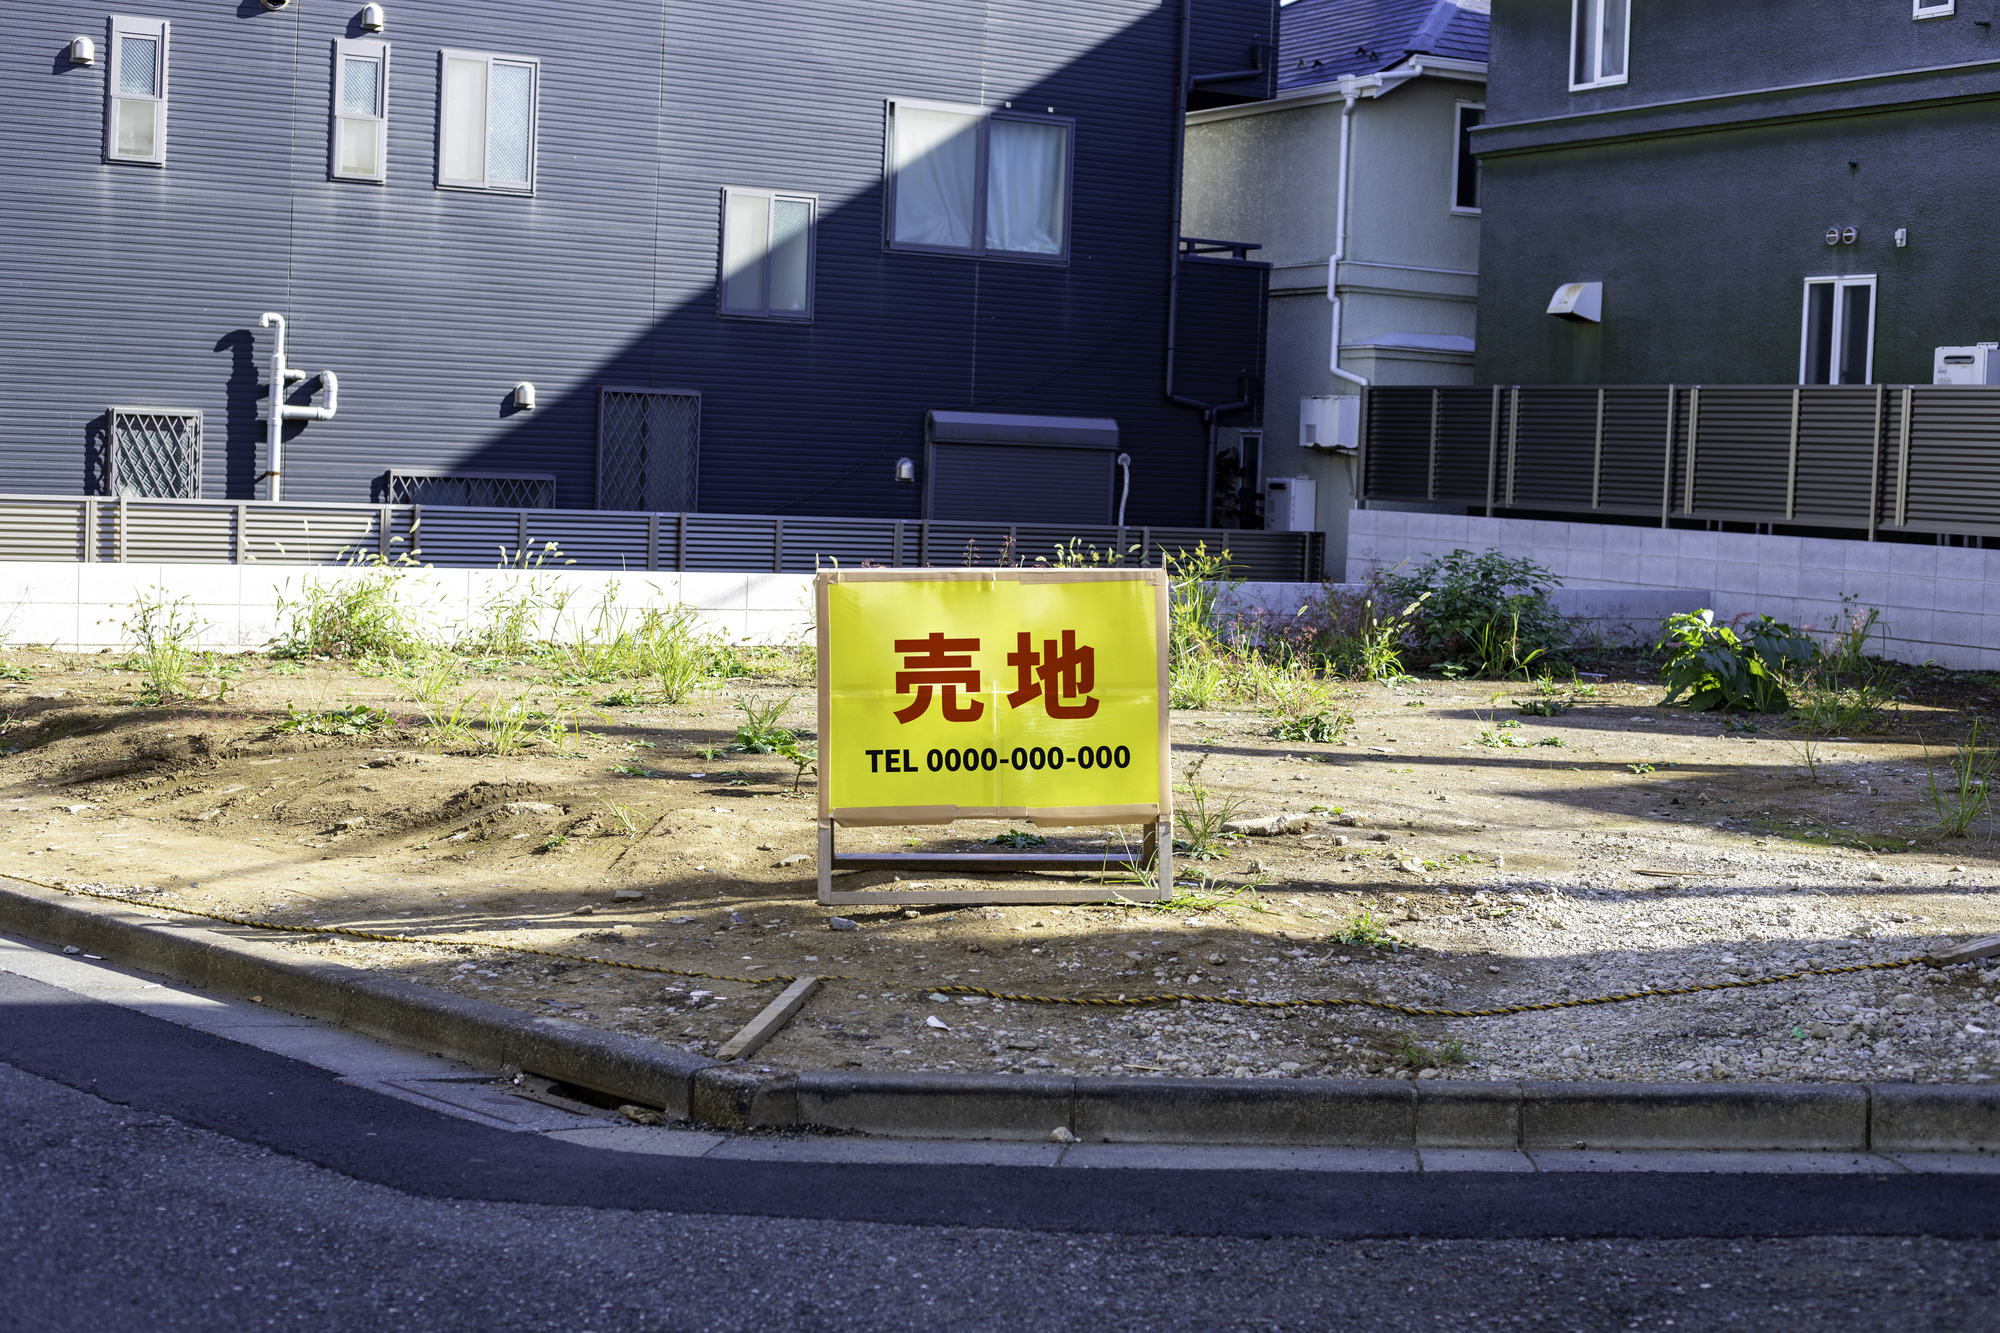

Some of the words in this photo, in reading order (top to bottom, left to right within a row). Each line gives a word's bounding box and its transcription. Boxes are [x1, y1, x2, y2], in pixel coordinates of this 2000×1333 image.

[893, 629, 1100, 725] 売地
[865, 749, 919, 773] TEL
[926, 745, 1131, 772] 0000-000-000
